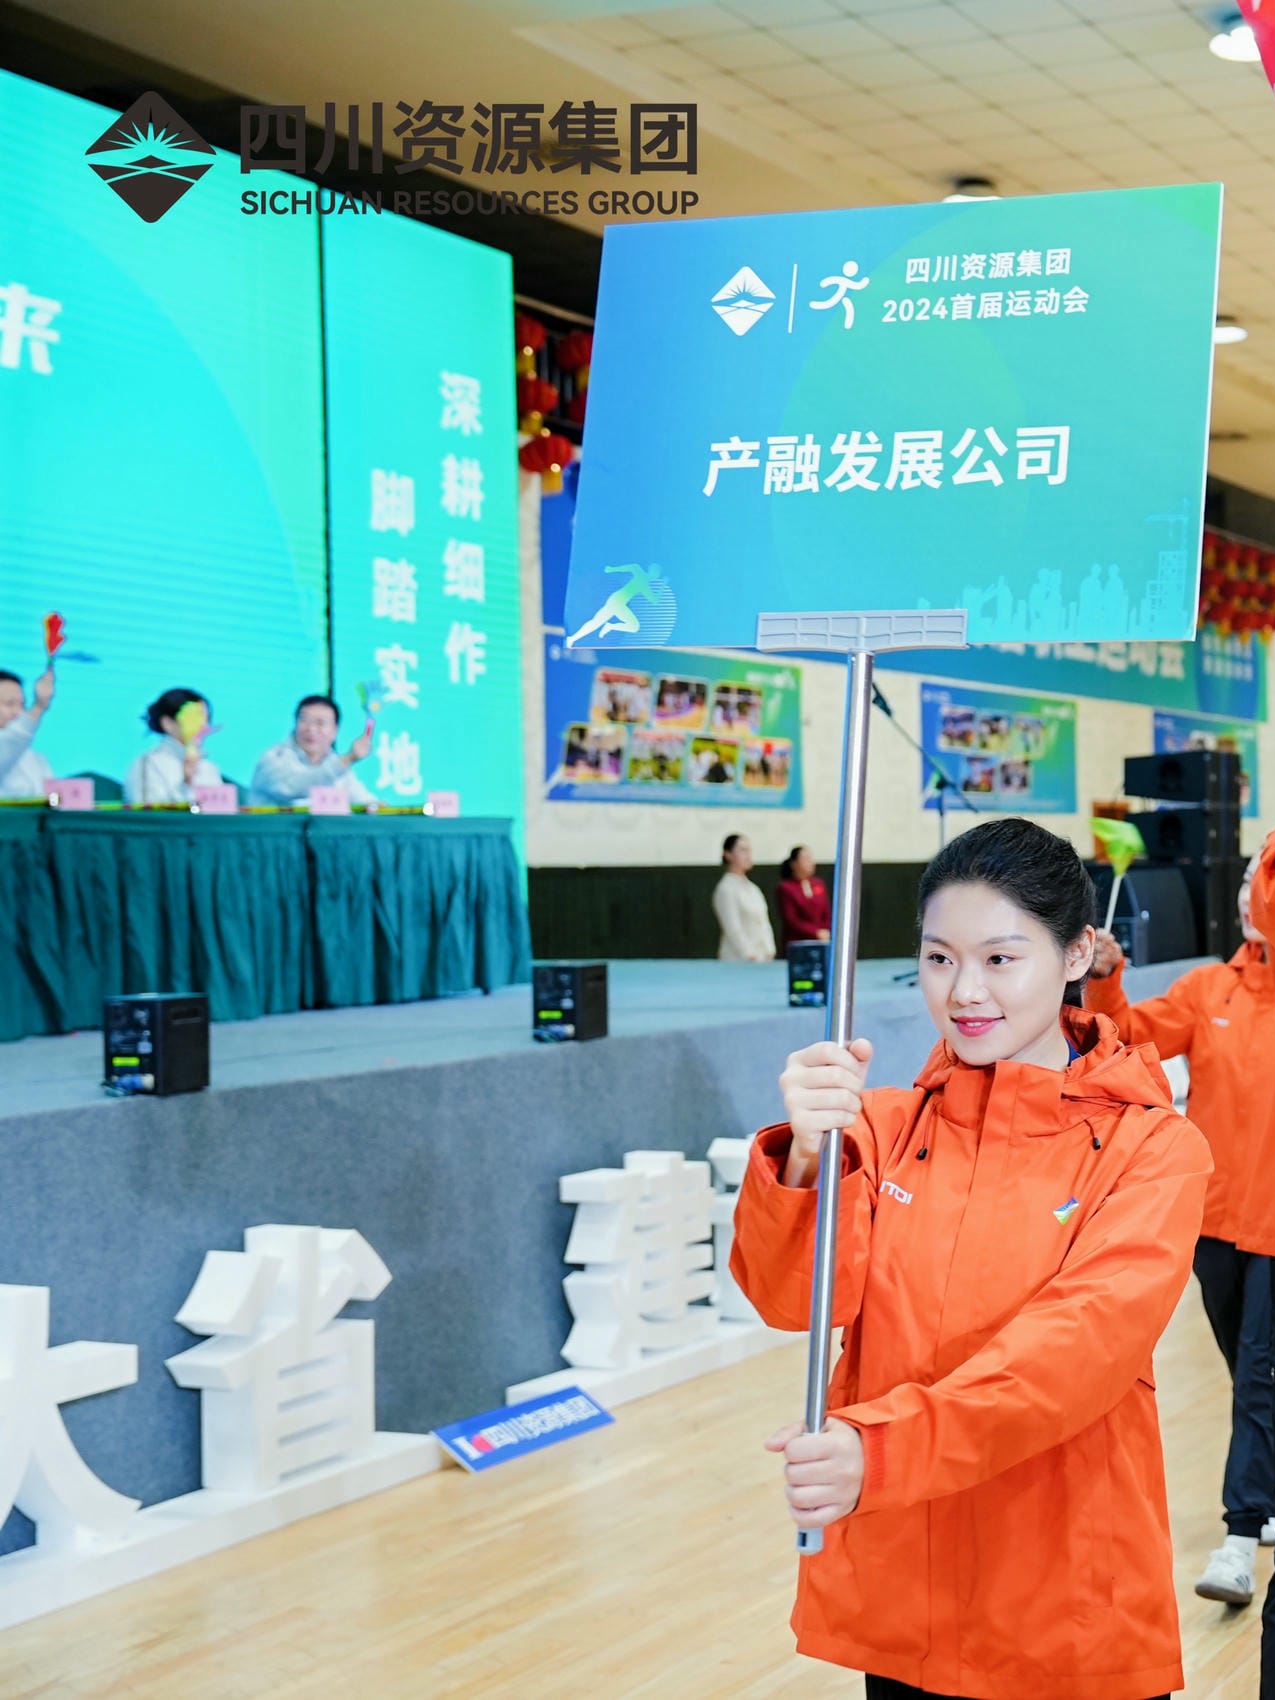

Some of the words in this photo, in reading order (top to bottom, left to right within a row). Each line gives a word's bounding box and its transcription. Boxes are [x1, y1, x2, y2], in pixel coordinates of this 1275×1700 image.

[905, 248, 1072, 284] 四川资源集团
[881, 286, 1090, 323] 2024首届运动会
[703, 425, 1071, 497] 产融发展公司
